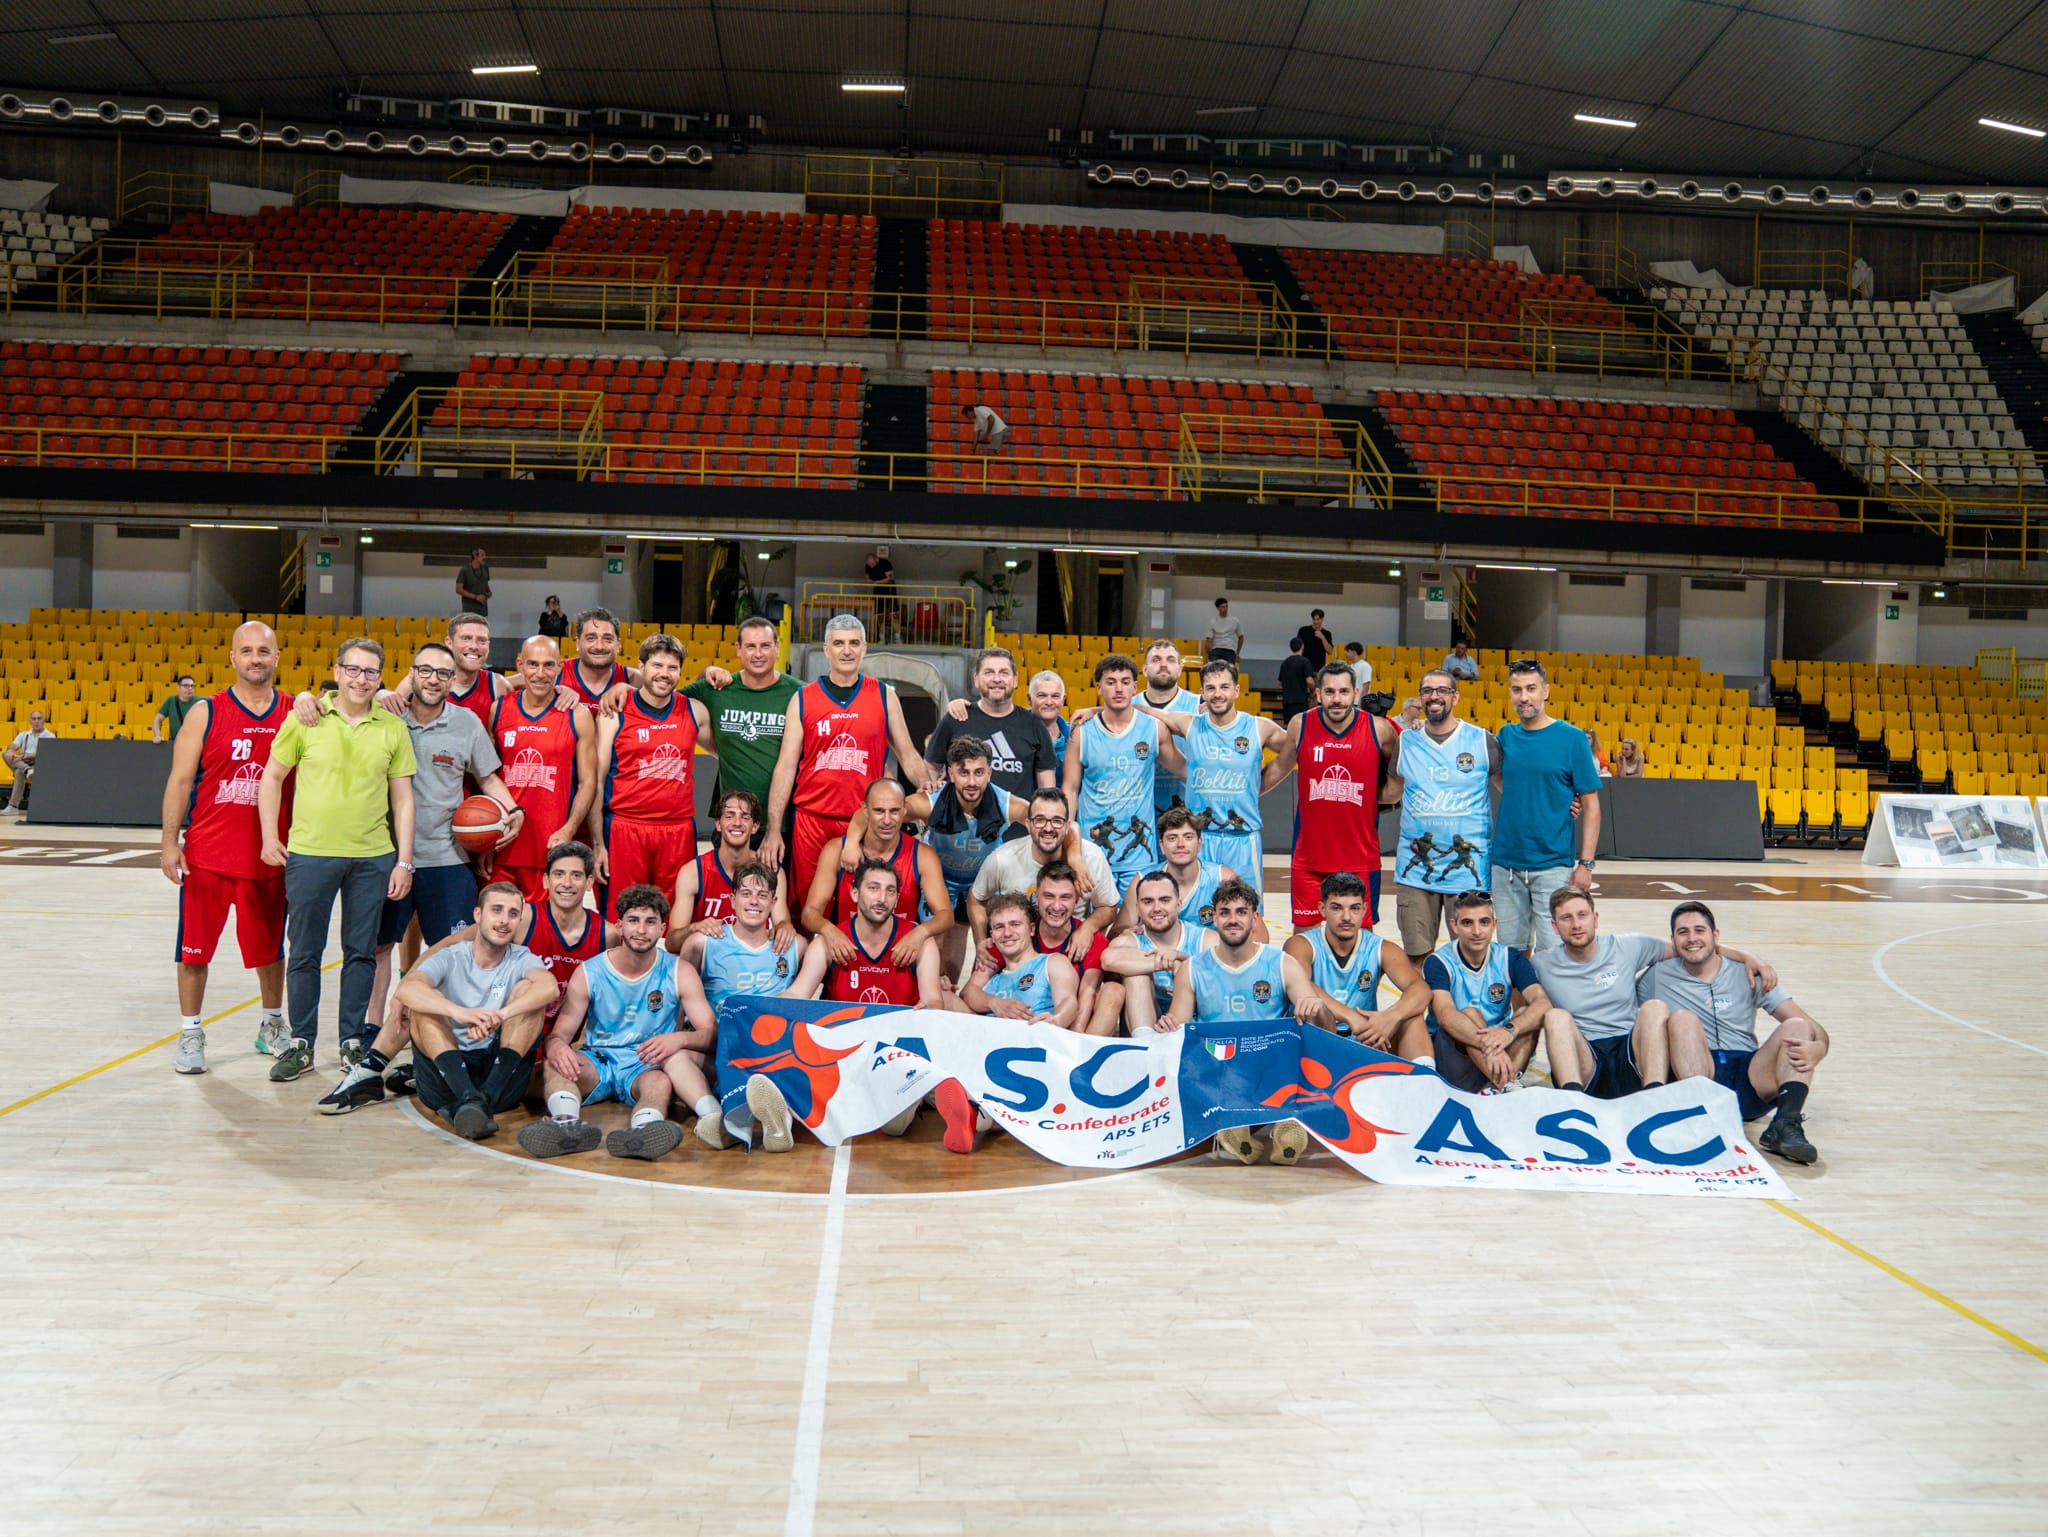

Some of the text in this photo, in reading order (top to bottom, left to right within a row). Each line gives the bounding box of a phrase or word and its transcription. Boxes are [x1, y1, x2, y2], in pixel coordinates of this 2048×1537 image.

[720, 708, 786, 726] JUMPING
[816, 719, 831, 736] 14
[503, 730, 517, 748] 16
[231, 738, 253, 761] 26
[1313, 746, 1324, 763] 11
[814, 747, 869, 776] MAGIC
[991, 756, 1023, 773] das
[1111, 755, 1130, 771] 10
[1191, 767, 1249, 789] Bolliti
[1428, 766, 1449, 783] 13
[215, 779, 261, 804] MAG
[1309, 777, 1364, 807] MAGIC
[954, 838, 982, 852] 45
[704, 898, 722, 917] 77
[850, 970, 859, 989] 9
[1223, 995, 1247, 1013] 16
[1265, 1031, 1301, 1040] PROMOZION
[1038, 1096, 1170, 1131] Confederate
[1102, 1111, 1171, 1142] APS ETS
